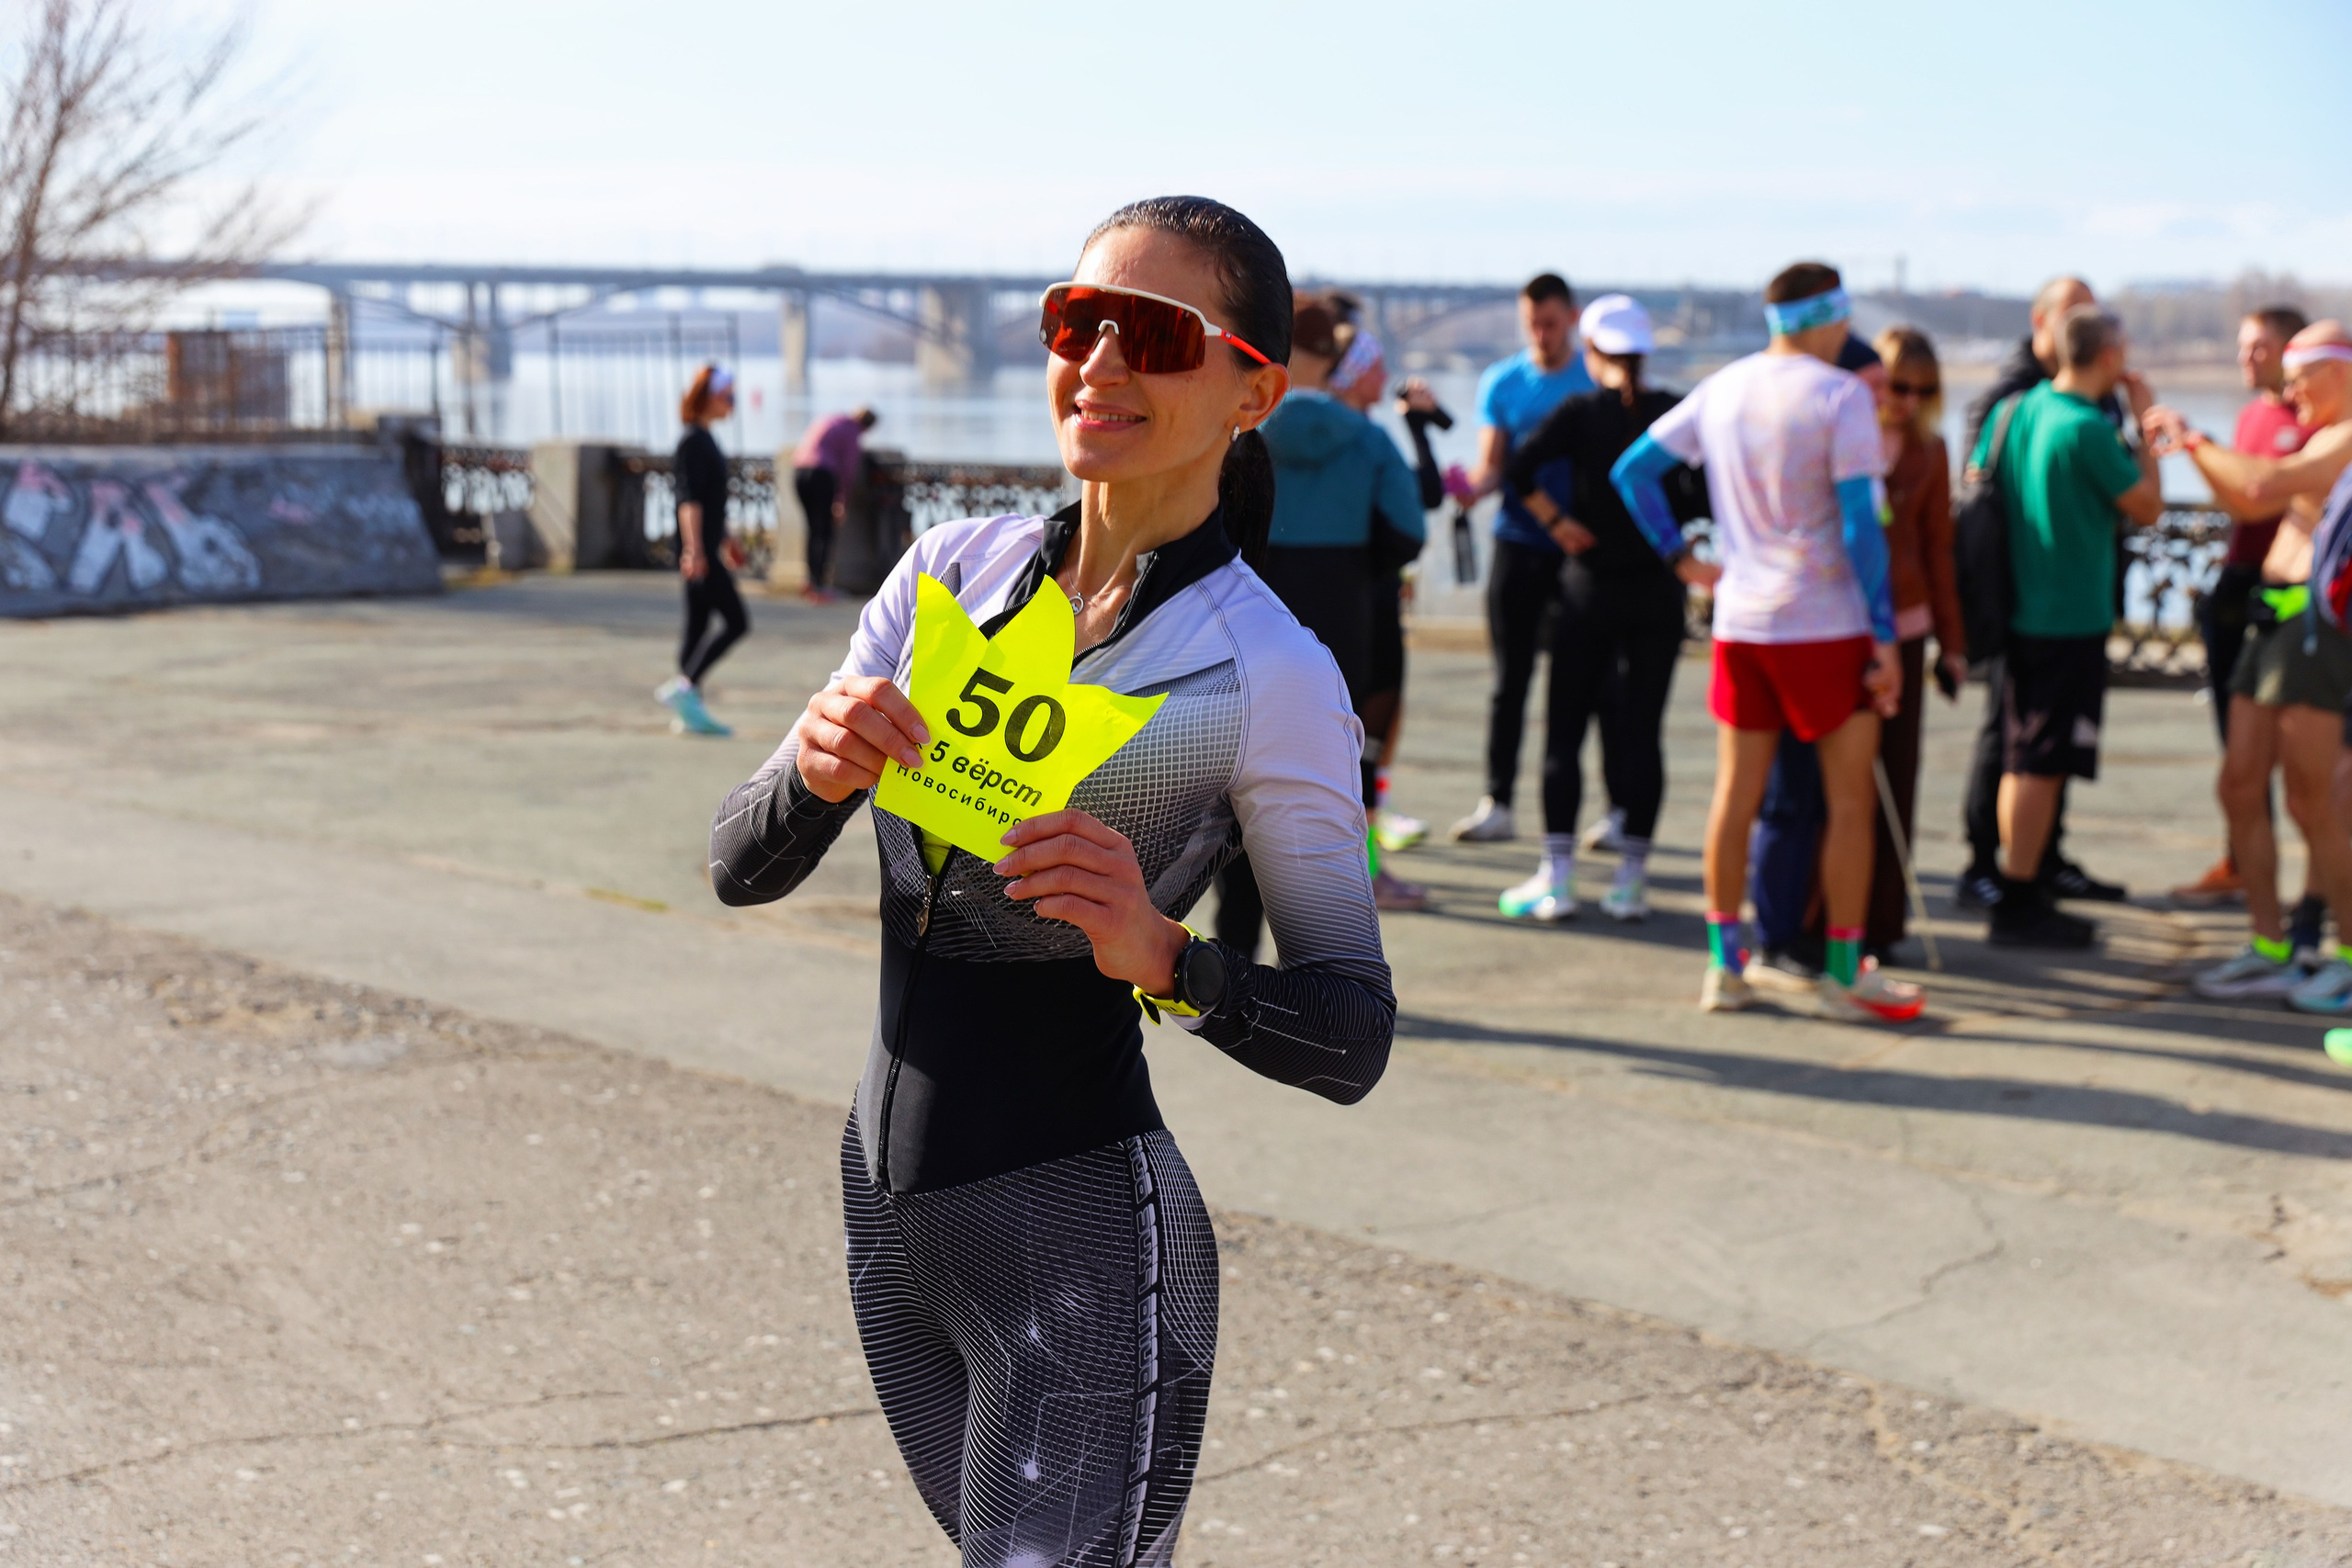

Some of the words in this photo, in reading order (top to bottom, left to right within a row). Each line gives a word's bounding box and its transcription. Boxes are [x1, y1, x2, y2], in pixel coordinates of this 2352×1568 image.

[946, 667, 1066, 761] 50
[897, 764, 1022, 826] Новосибирс
[930, 740, 950, 762] 5
[952, 756, 1043, 807] вёрст
